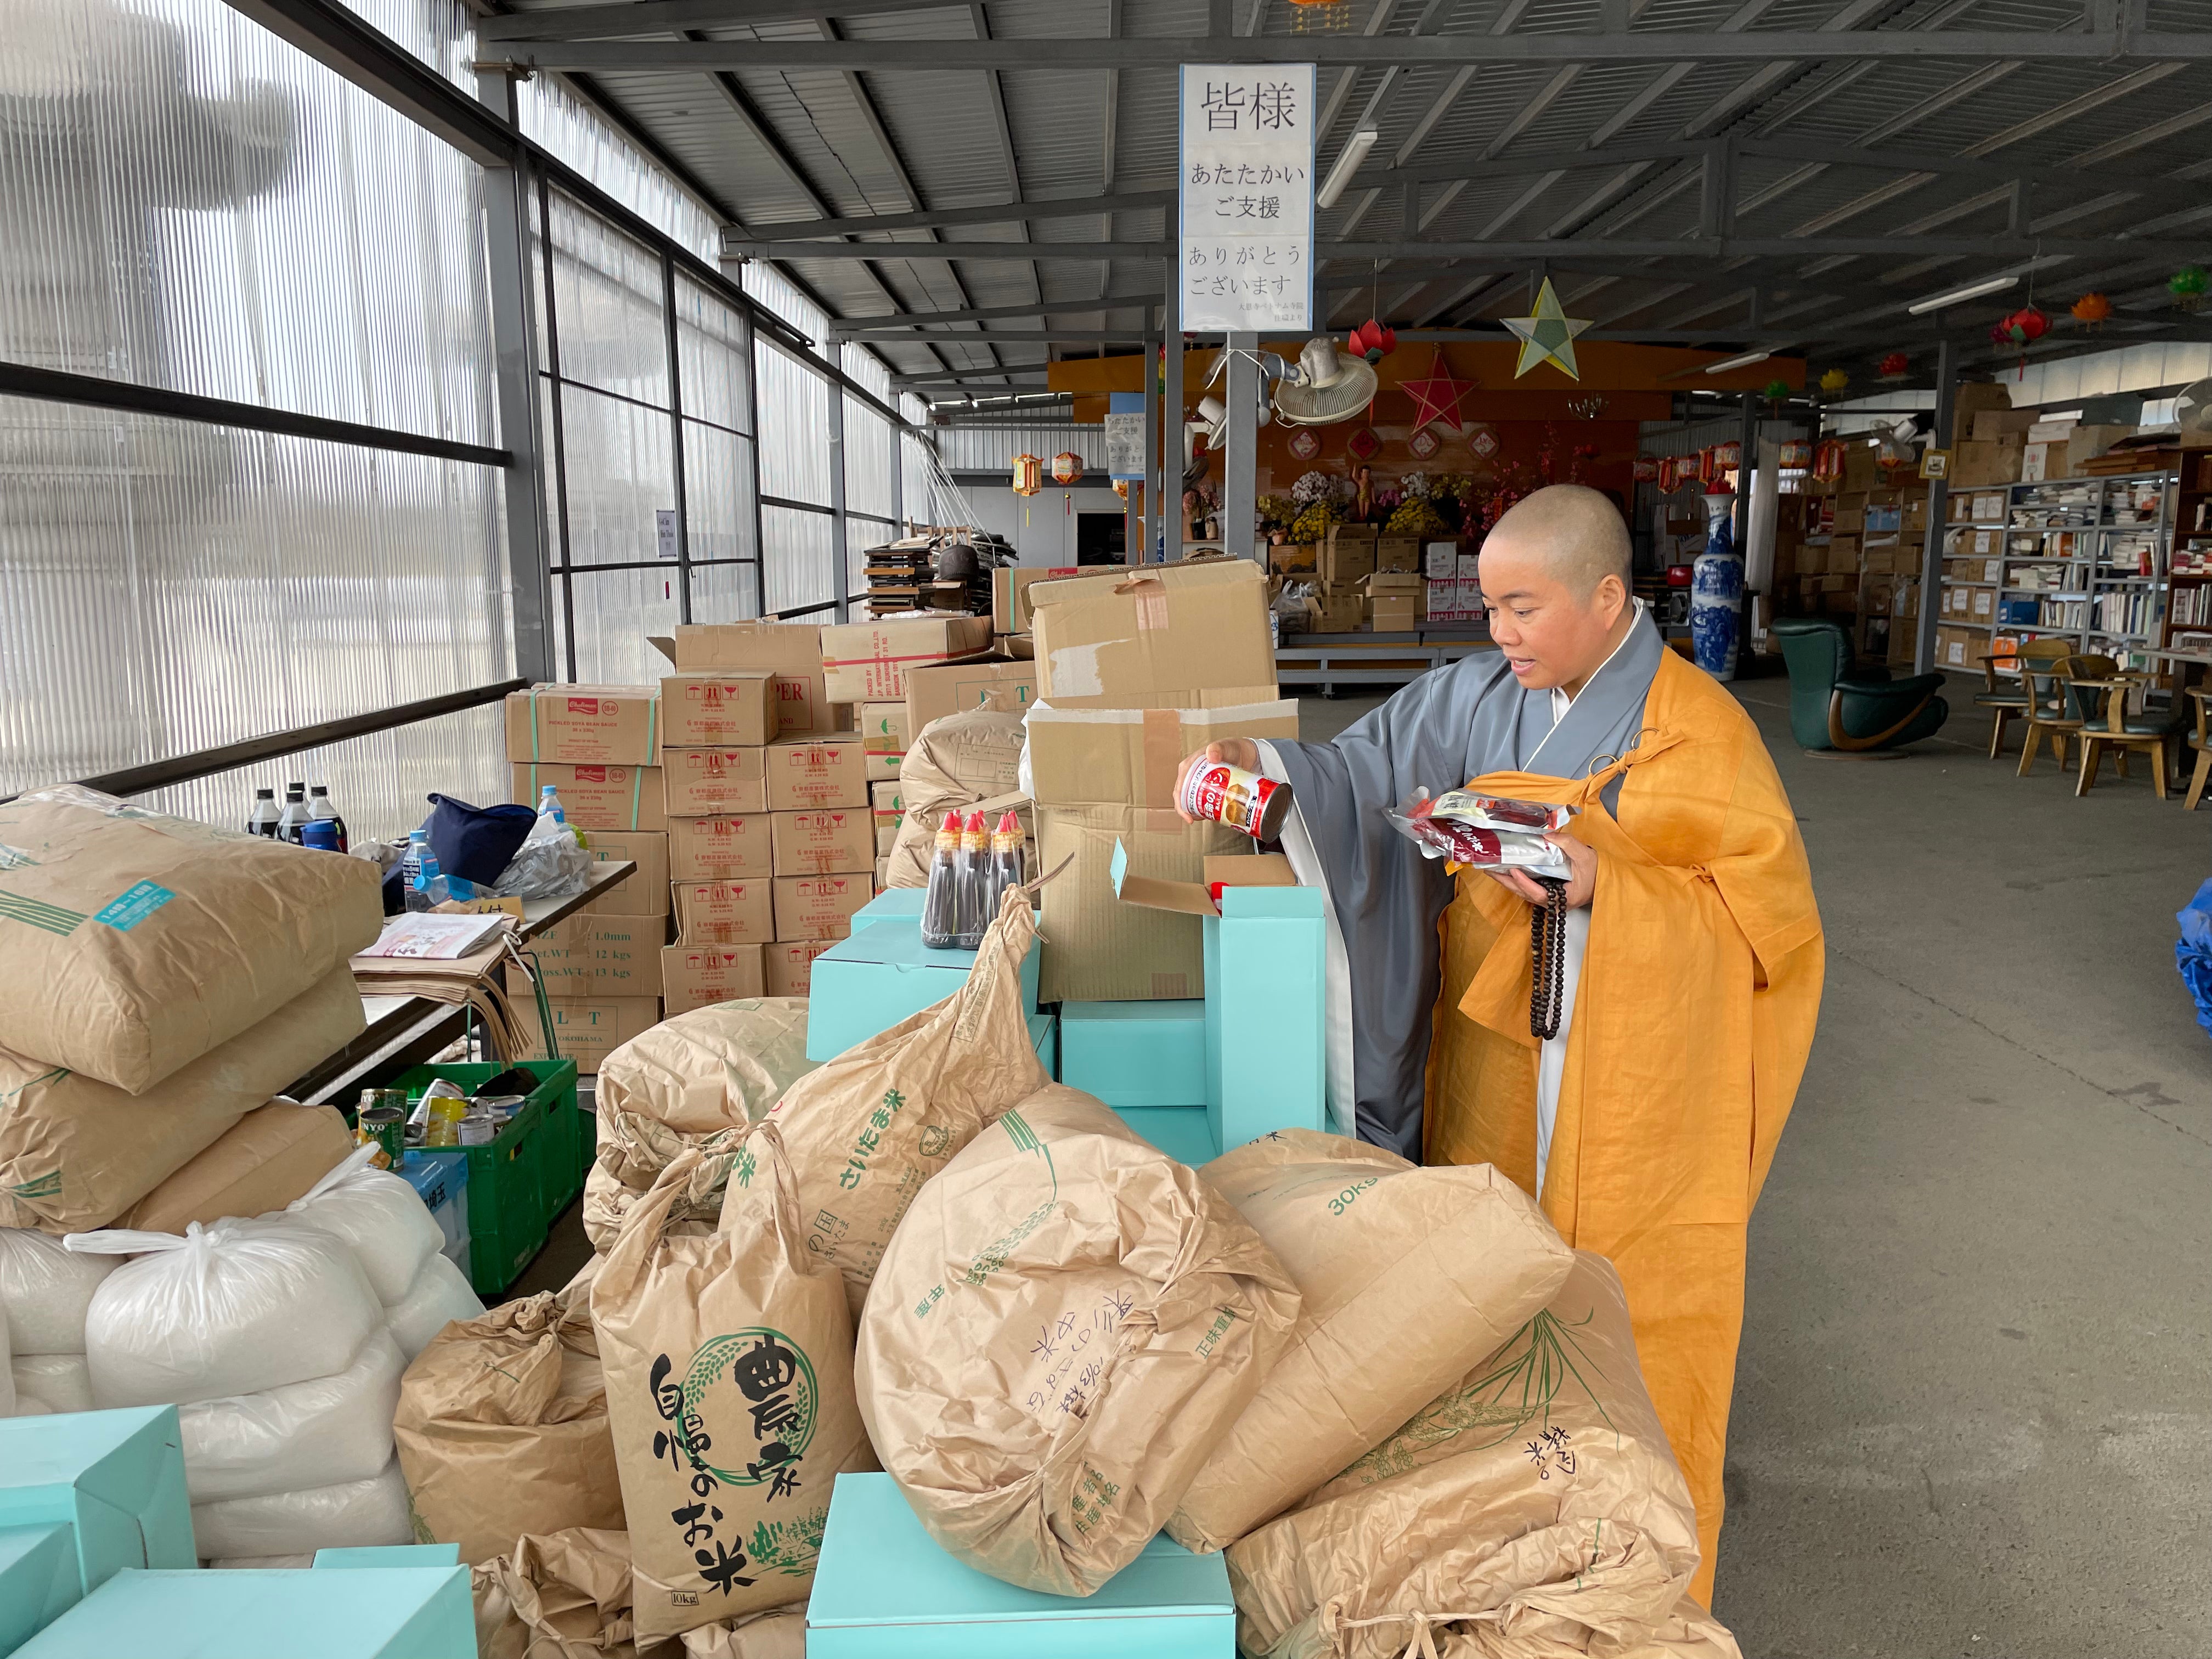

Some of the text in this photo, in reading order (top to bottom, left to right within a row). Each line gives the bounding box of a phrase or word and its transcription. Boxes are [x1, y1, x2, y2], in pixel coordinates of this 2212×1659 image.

[1201, 82, 1296, 131] 皆様
[1192, 163, 1304, 184] あたたかい
[1215, 196, 1280, 219] ご支援
[1189, 246, 1300, 266] ありがとう
[1190, 275, 1291, 295] ございます
[535, 932, 557, 940] IZE
[596, 932, 631, 941] 1.0mm
[596, 950, 607, 959] 12
[613, 950, 631, 961] kgs
[596, 968, 607, 977] 13
[613, 968, 631, 979] kgs
[557, 1011, 601, 1025] L T
[363, 1093, 375, 1103] YO
[362, 1122, 385, 1131] NYO
[839, 1088, 906, 1190] さいたま米
[734, 1334, 804, 1503] 農家
[650, 1353, 759, 1598] 自慢のお米
[1072, 1469, 1104, 1513] 産者名
[673, 1593, 698, 1605] 10kg
